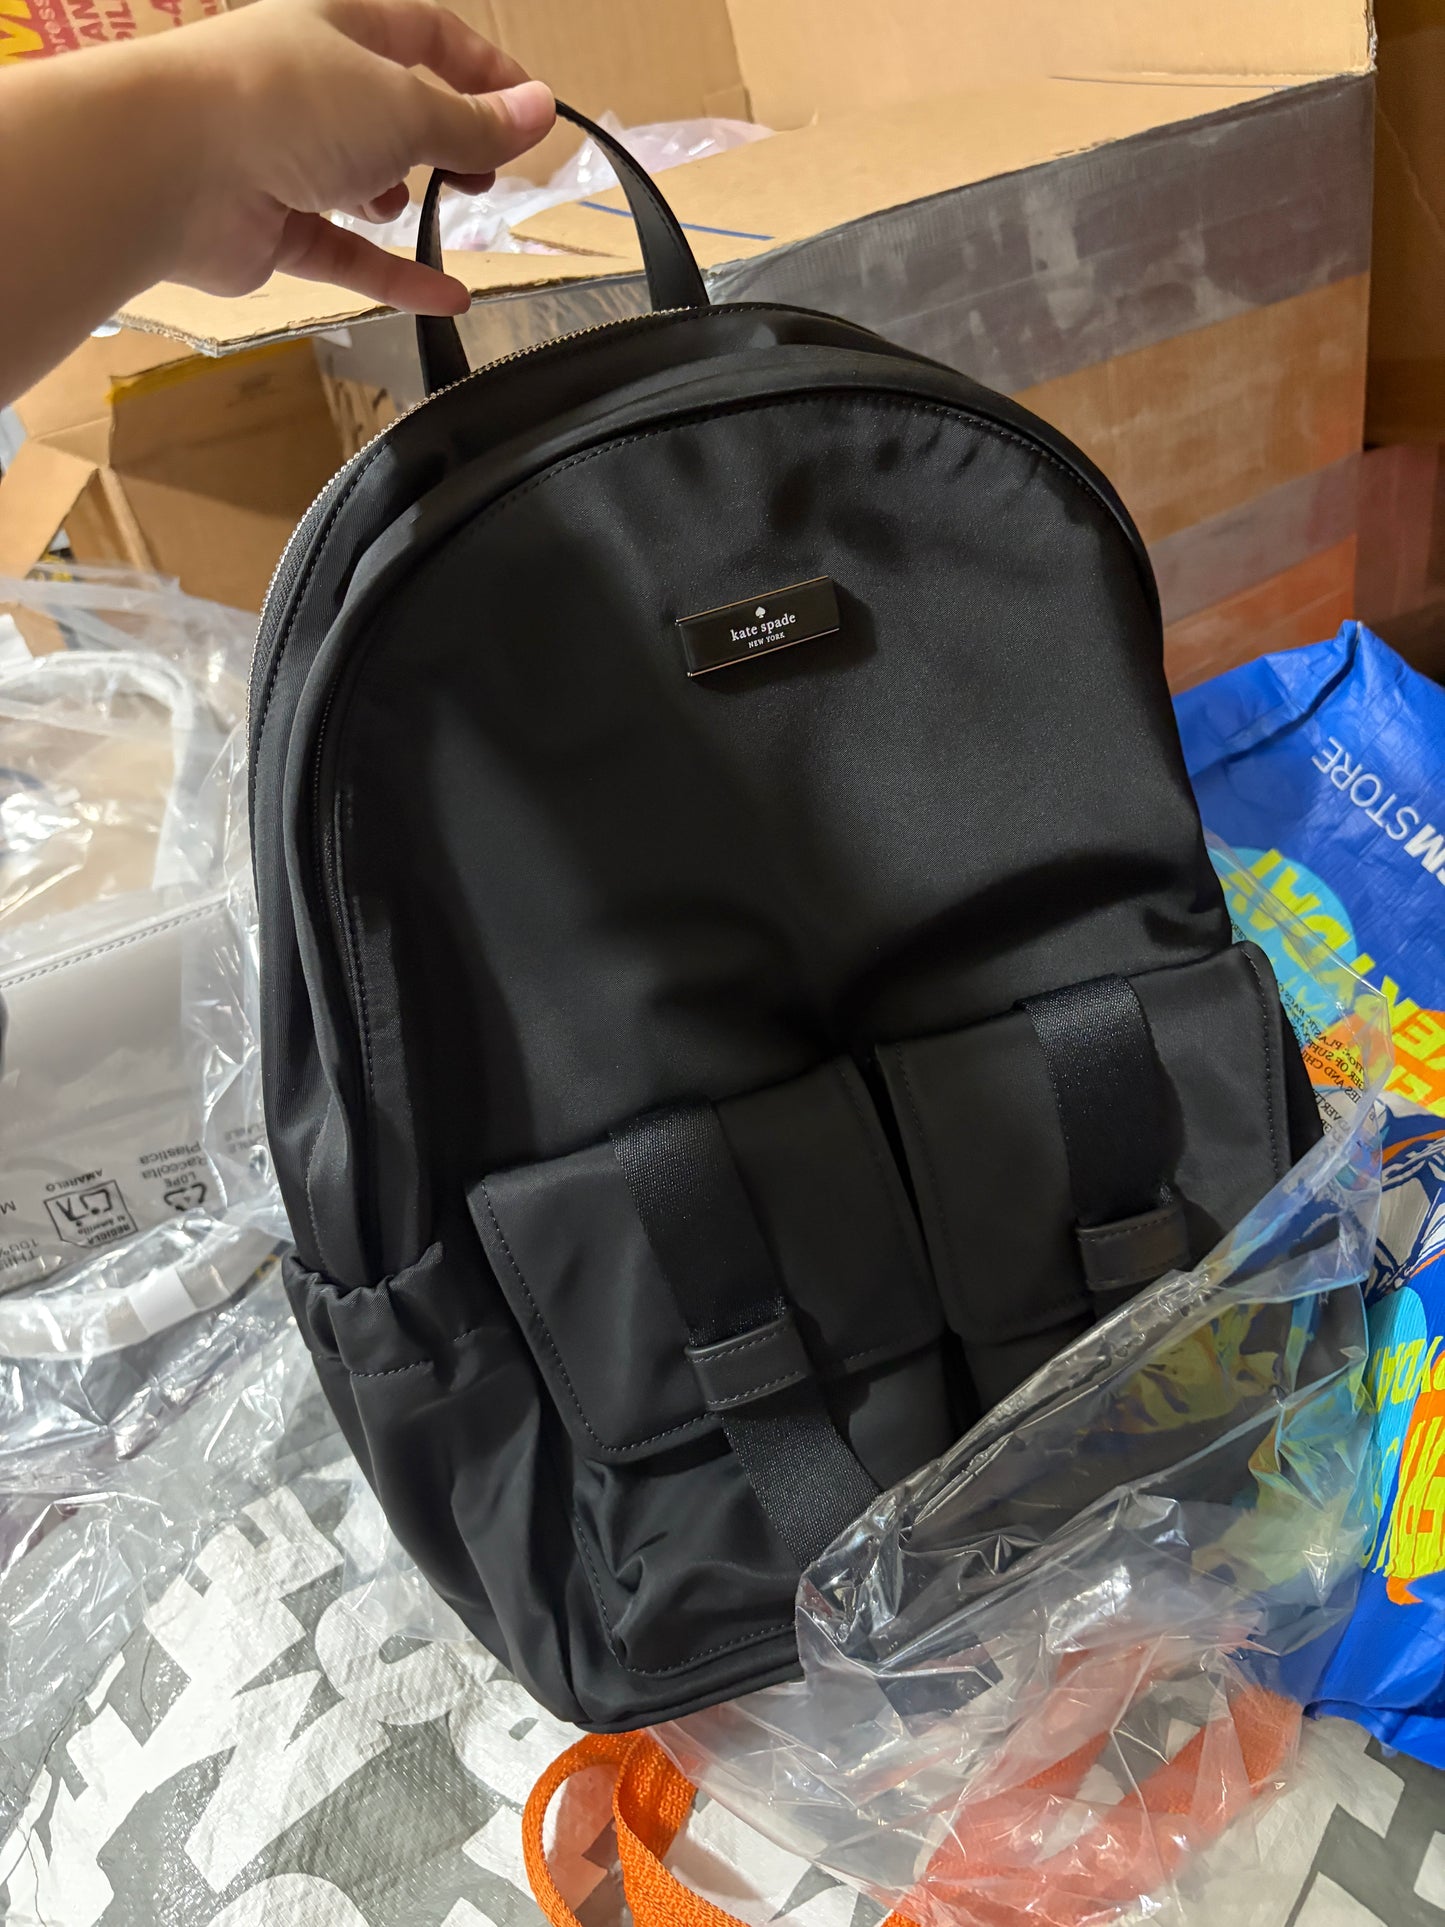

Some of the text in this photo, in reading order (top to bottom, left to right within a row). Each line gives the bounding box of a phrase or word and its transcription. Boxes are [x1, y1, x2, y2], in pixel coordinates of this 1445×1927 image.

[730, 613, 796, 642] kate spade
[748, 631, 785, 649] NEW YORK
[139, 1140, 201, 1164] Plastica
[142, 1156, 208, 1179] Raccolta
[164, 1171, 197, 1187] LDPE
[46, 1168, 103, 1192] AMARELO
